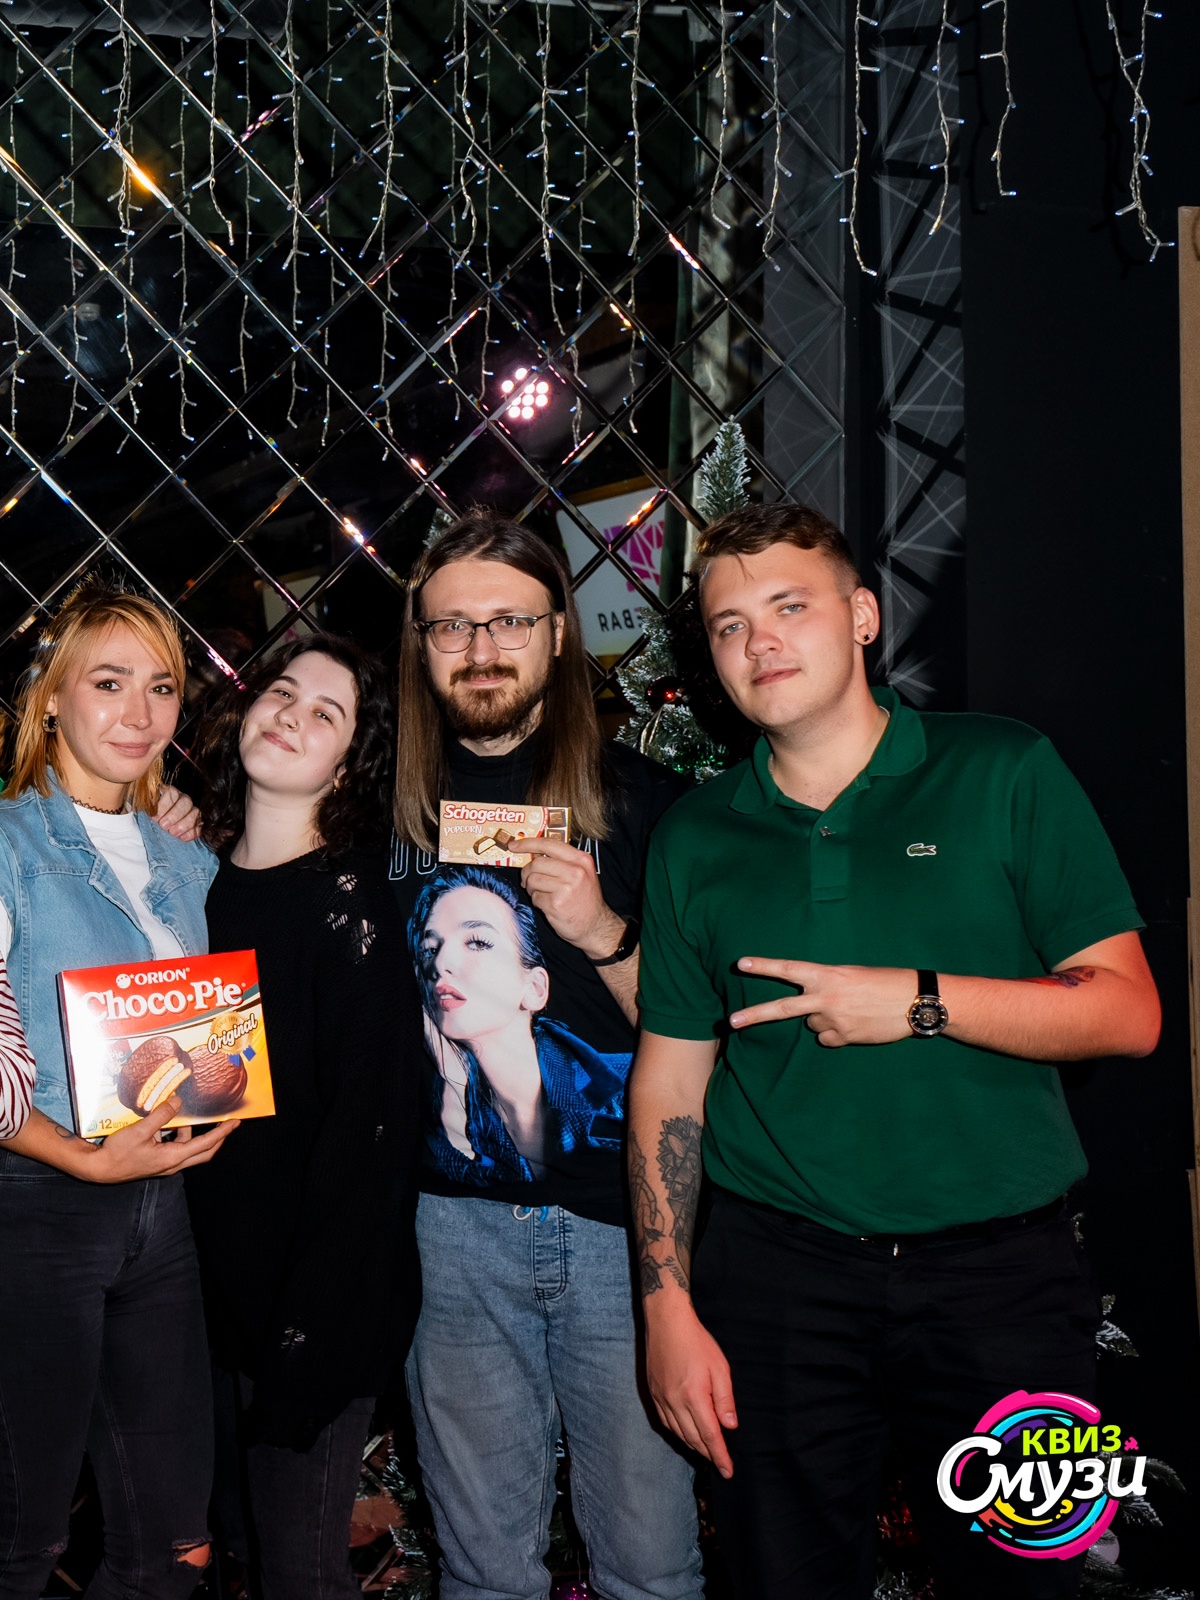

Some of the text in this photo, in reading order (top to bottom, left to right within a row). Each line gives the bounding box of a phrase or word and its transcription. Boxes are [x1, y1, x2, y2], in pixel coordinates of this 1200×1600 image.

[443, 804, 526, 824] Schogetten
[443, 825, 483, 836] POPCORN
[134, 969, 188, 986] ORION
[207, 1013, 258, 1055] Original
[99, 1118, 113, 1130] 12
